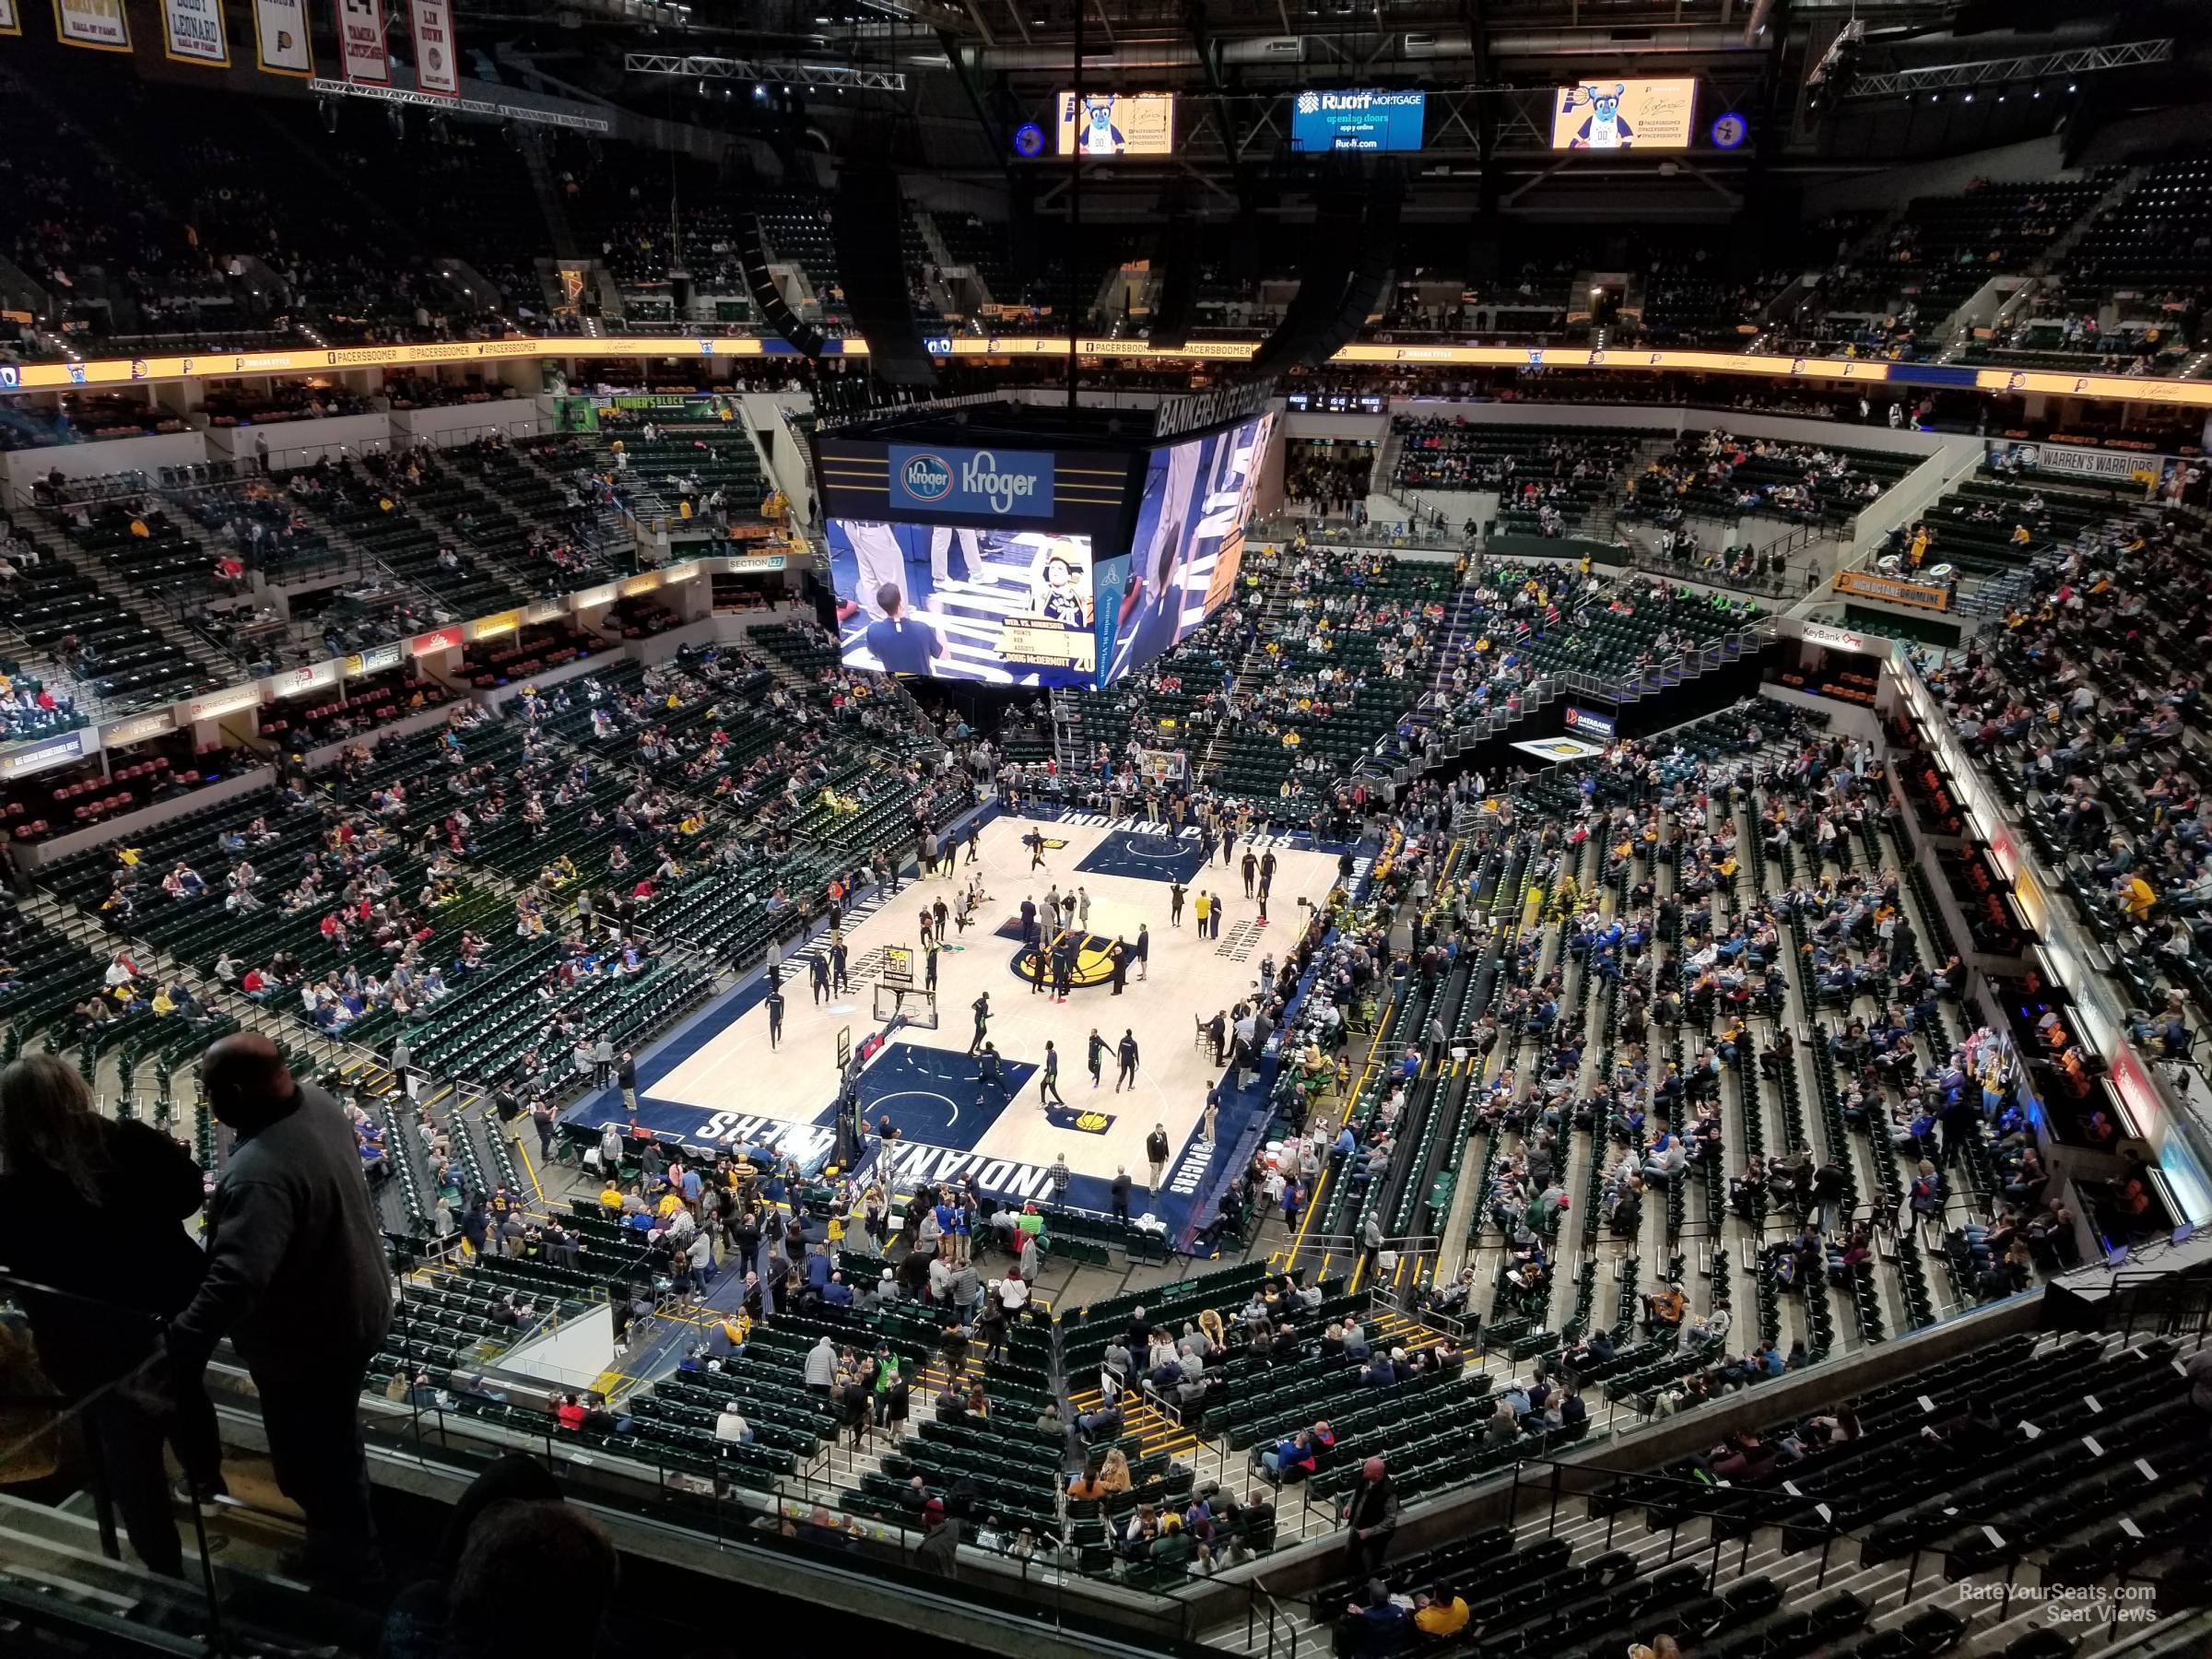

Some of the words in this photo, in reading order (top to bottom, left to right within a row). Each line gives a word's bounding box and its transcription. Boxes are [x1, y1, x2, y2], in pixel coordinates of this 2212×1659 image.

[172, 13, 218, 42] LEONARD
[421, 27, 443, 42] DUNN
[1322, 93, 1372, 110] Ruoff
[1372, 95, 1421, 105] MORTGAGE
[1326, 114, 1362, 124] opening
[1364, 113, 1389, 123] doors
[337, 349, 397, 362] PACERSBOOMER
[417, 346, 469, 359] PACERSBOOMER
[485, 342, 536, 353] @PACERSBOOMER
[1184, 346, 1251, 355] PACERSBOOMER
[614, 396, 656, 409] TURNER'S
[656, 396, 685, 406] BLOCK
[1156, 392, 1219, 438] BANKERS
[1215, 386, 1241, 424] LIFE
[2043, 450, 2094, 470] WARREN'S
[2096, 454, 2153, 475] WARRIORS
[908, 461, 947, 495] Kroger
[962, 451, 1037, 513] Kroger
[730, 559, 768, 568] SECTION
[1872, 582, 1900, 597] OCTANE
[1900, 588, 1939, 605] DRUMLINE
[1104, 595, 1113, 635] Ascension
[1803, 627, 1841, 642] KeyBank
[1006, 653, 1027, 664] DOUG
[1027, 655, 1070, 667] McDERMOTT
[1074, 655, 1095, 673] 20
[1100, 647, 1109, 678] Vincent
[1578, 715, 1611, 731] DATABANK
[1056, 812, 1169, 837] INDIANA
[1214, 920, 1252, 958] FIELDHOUSE
[1240, 923, 1267, 947] ANKERS
[1230, 948, 1252, 963] LIFE
[1169, 1143, 1214, 1194] @PACERS
